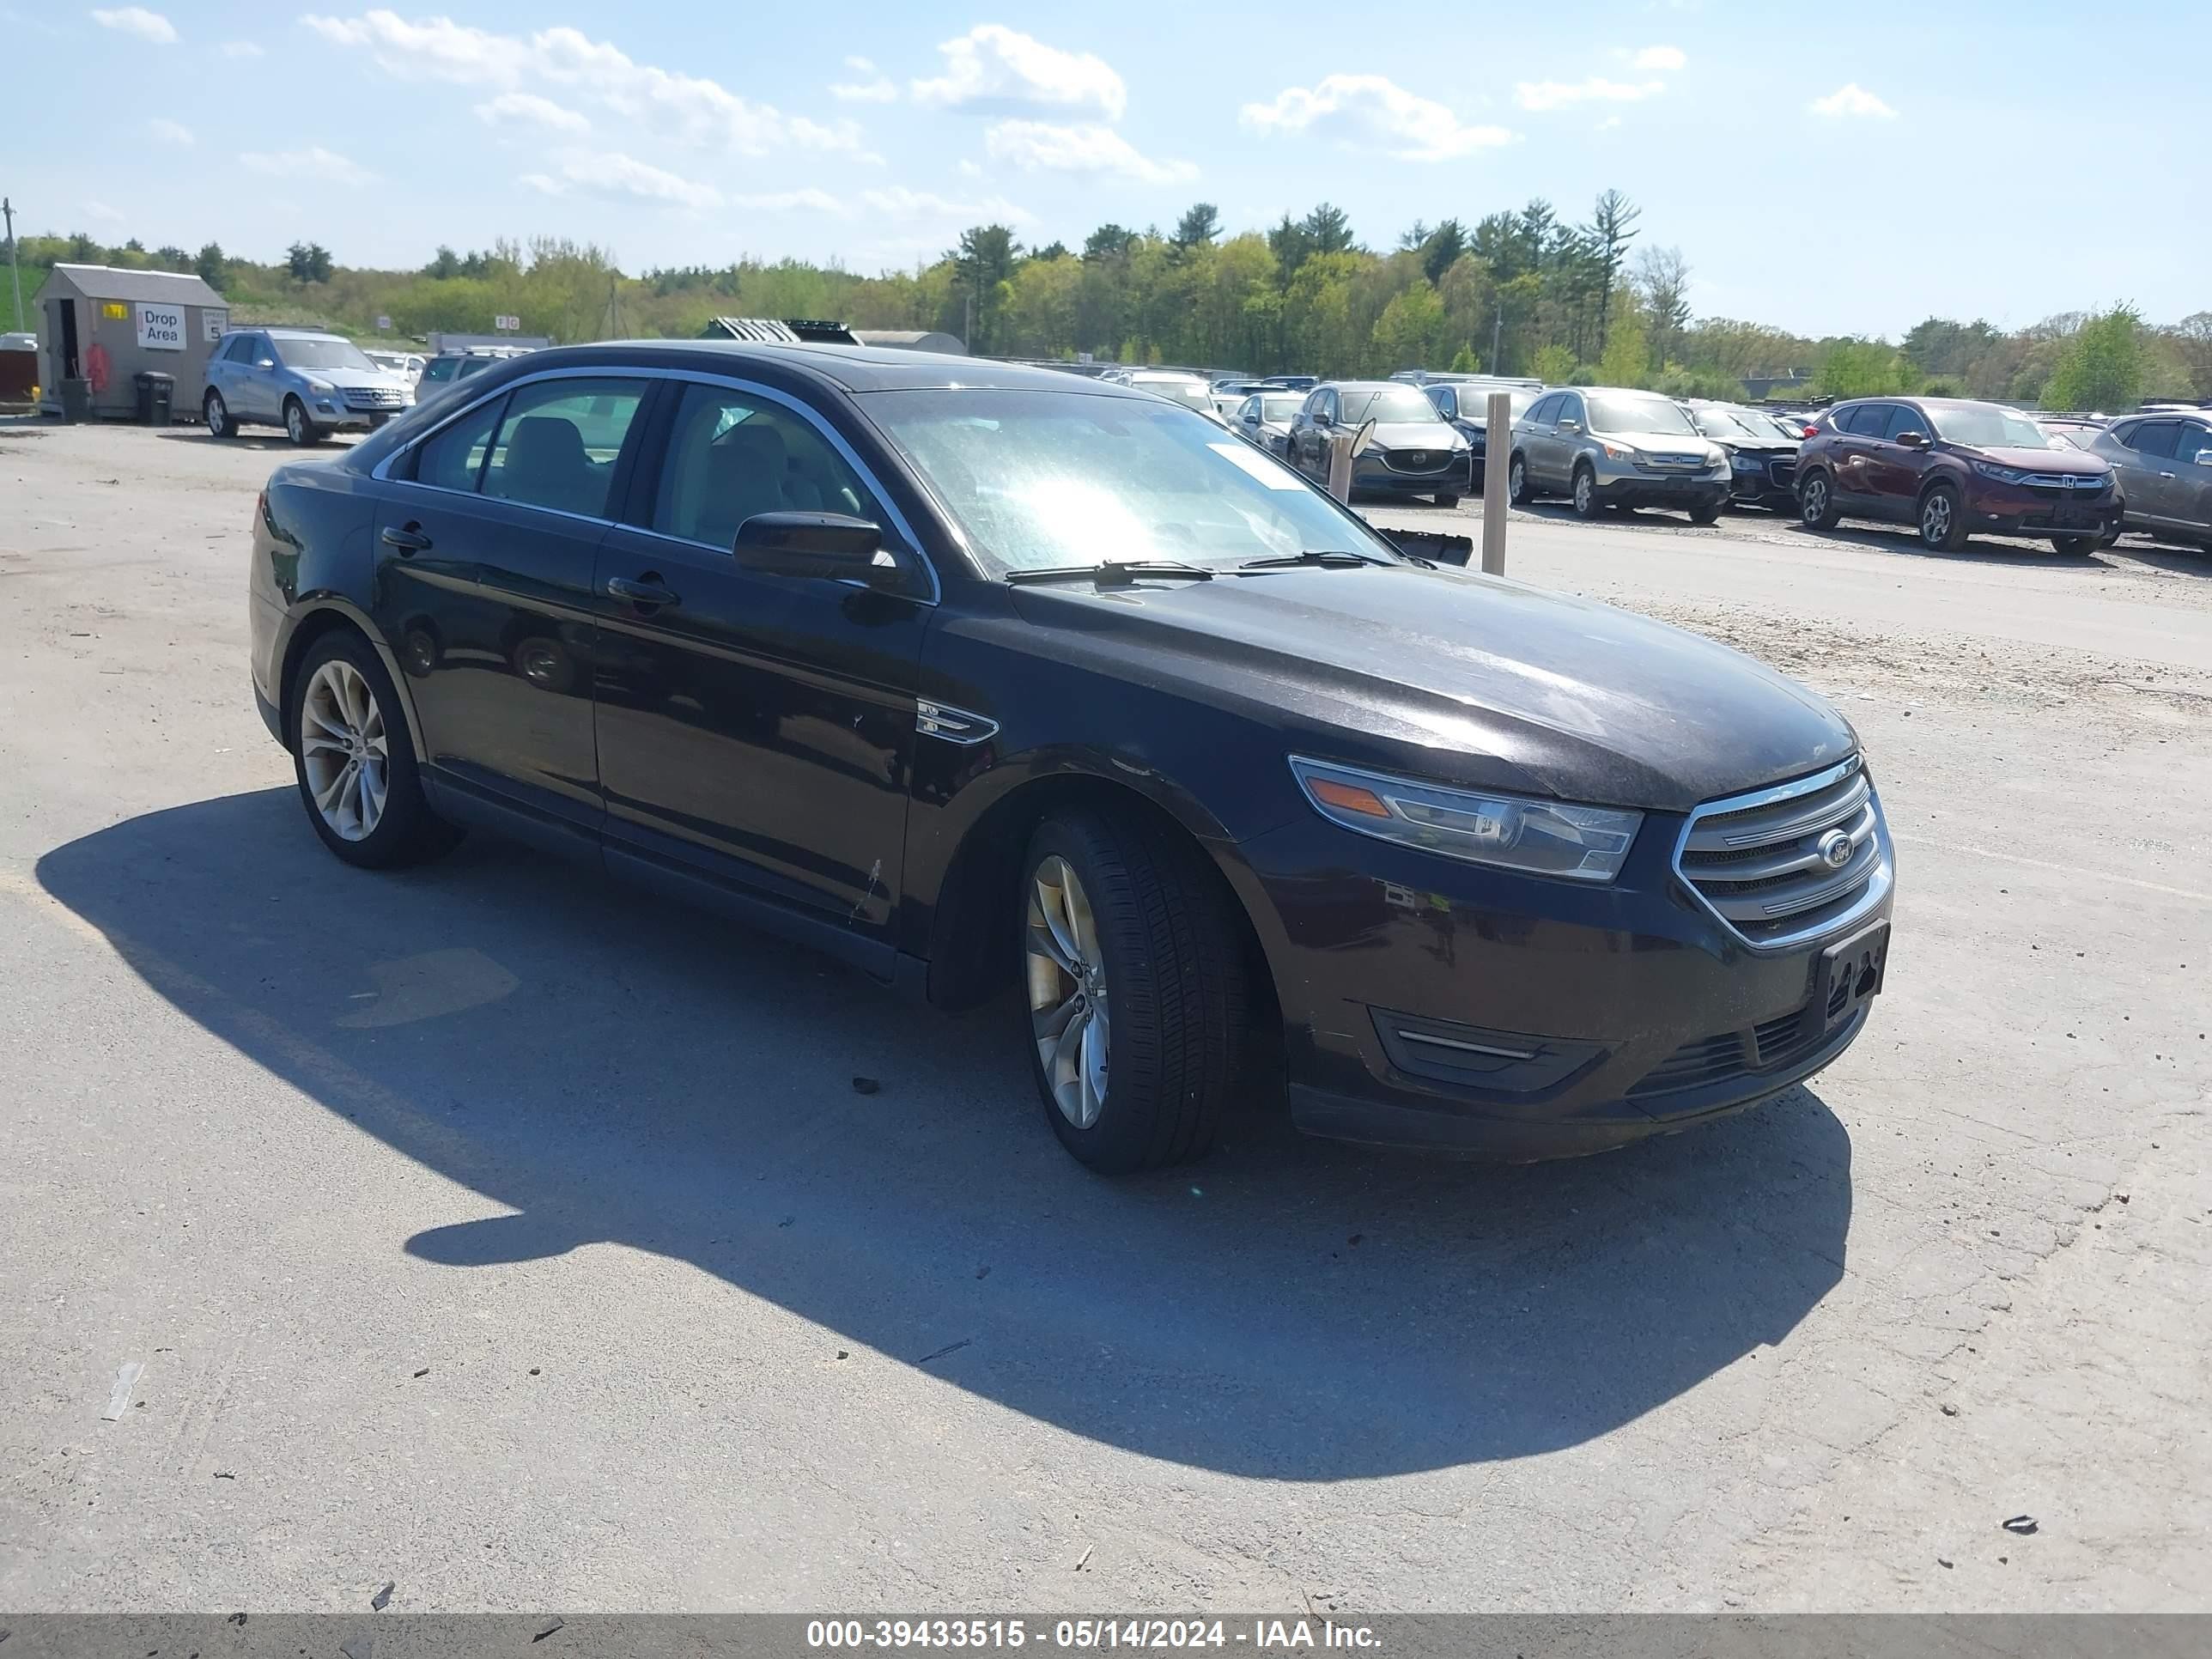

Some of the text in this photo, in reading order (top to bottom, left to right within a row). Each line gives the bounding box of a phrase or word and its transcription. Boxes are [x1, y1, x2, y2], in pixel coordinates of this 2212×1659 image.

[145, 311, 177, 327] Drop
[147, 327, 178, 342] Area
[211, 326, 221, 339] 5
[1834, 841, 1850, 861] Ford
